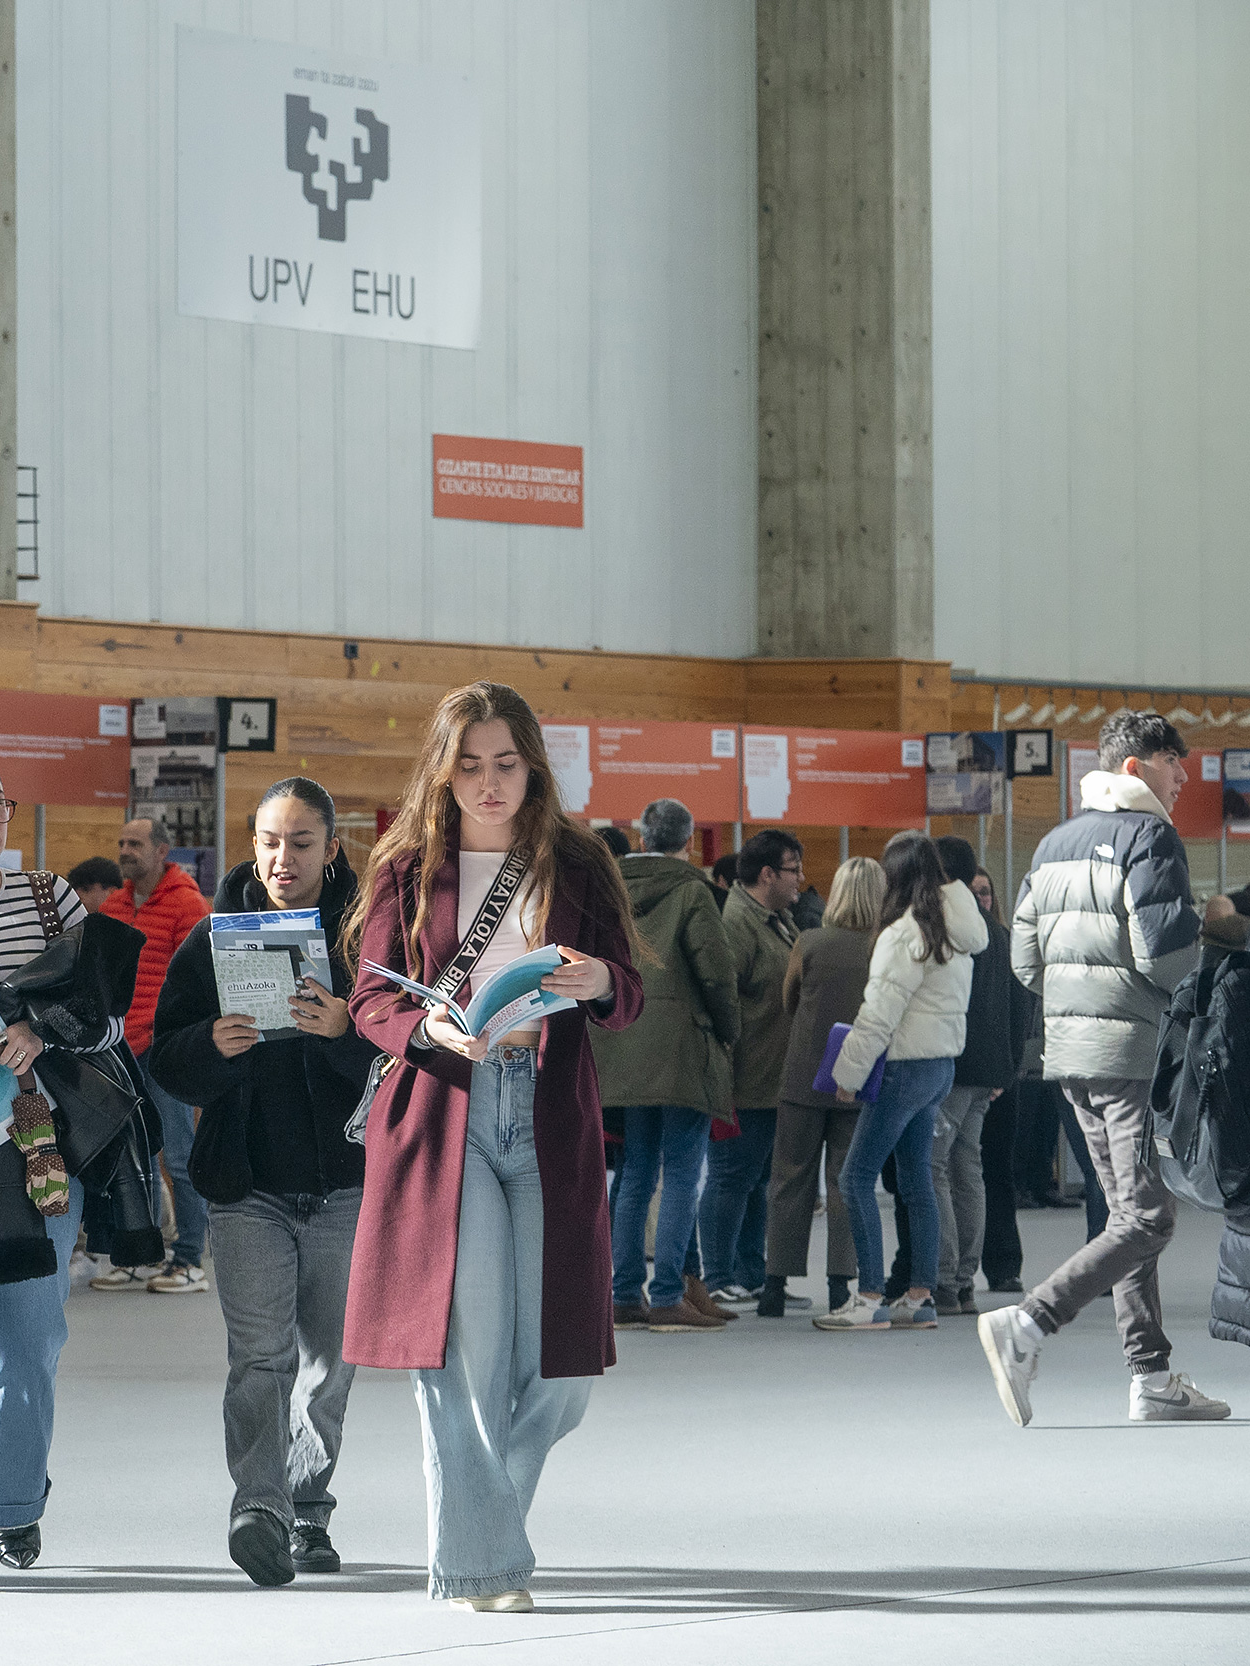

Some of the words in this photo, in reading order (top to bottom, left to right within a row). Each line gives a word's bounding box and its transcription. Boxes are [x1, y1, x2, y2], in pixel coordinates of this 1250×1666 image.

[249, 254, 313, 307] UPV
[351, 268, 416, 320] EHU
[483, 461, 504, 480] ETA
[438, 477, 483, 496] CIENCIAS
[483, 480, 528, 500] SOCIALES
[227, 981, 277, 992] ehuAzoka
